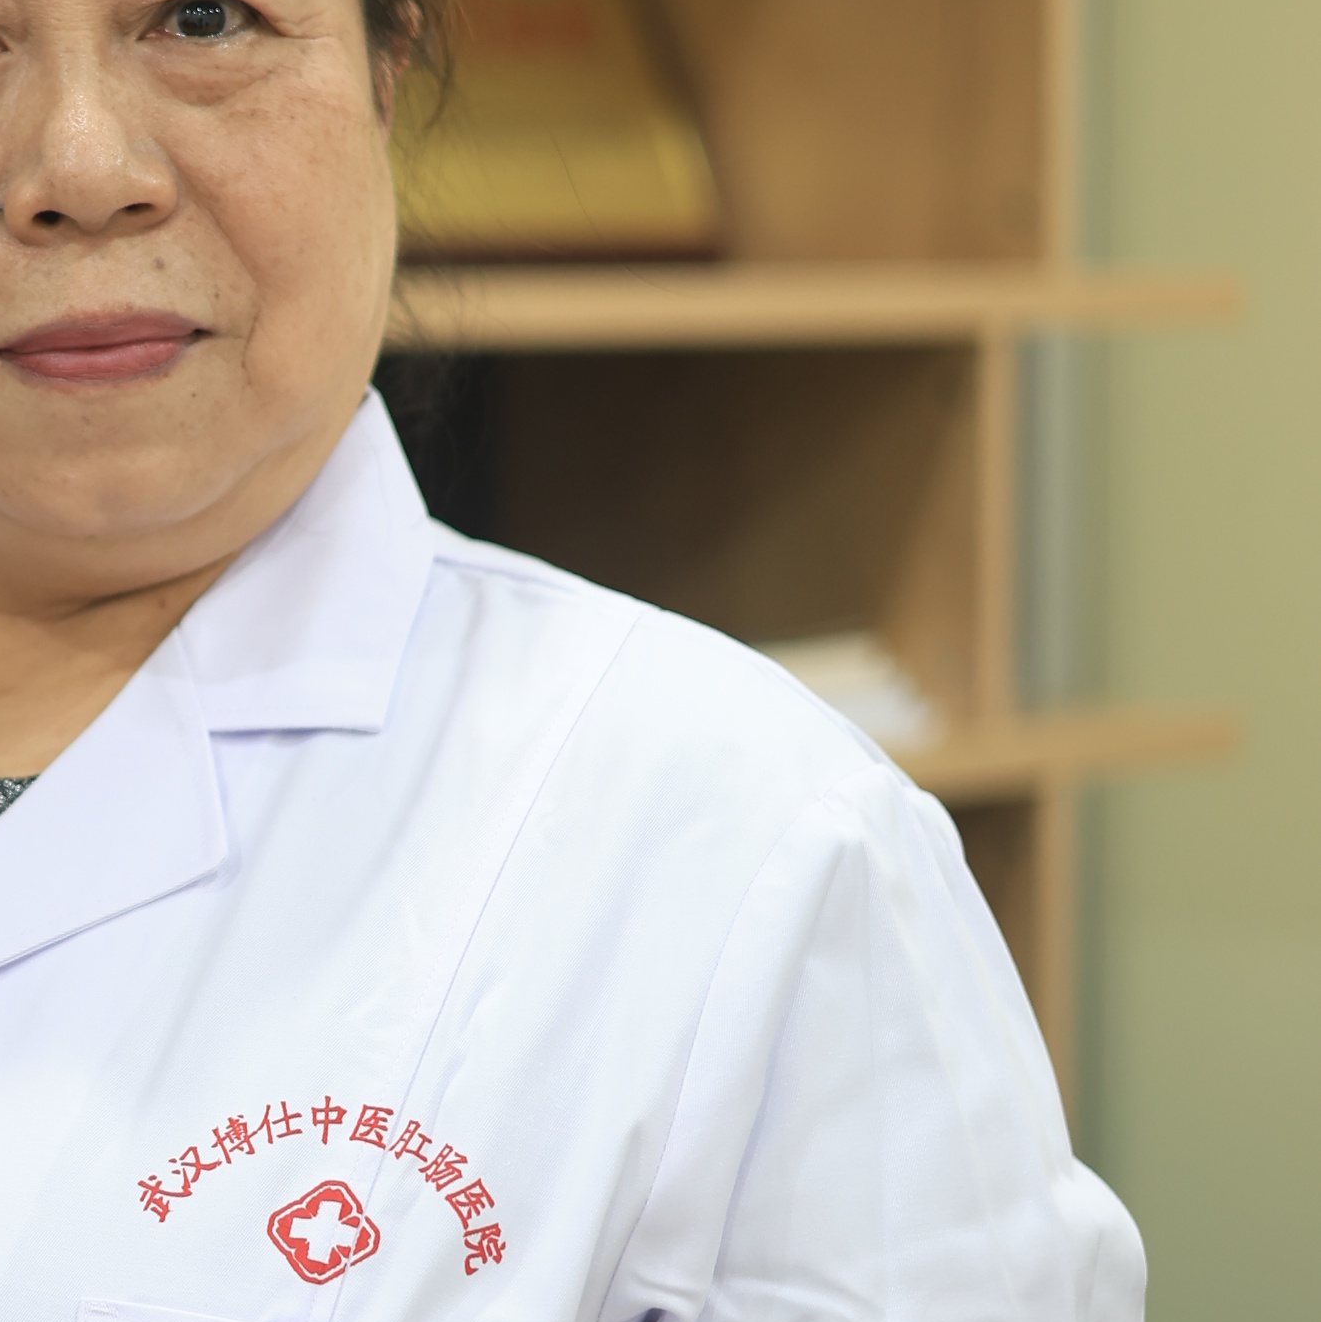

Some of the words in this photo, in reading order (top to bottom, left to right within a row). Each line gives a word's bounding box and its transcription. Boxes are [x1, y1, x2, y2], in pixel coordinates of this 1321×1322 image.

[138, 1095, 506, 1276] 武汉博仕中医肛肠医院
